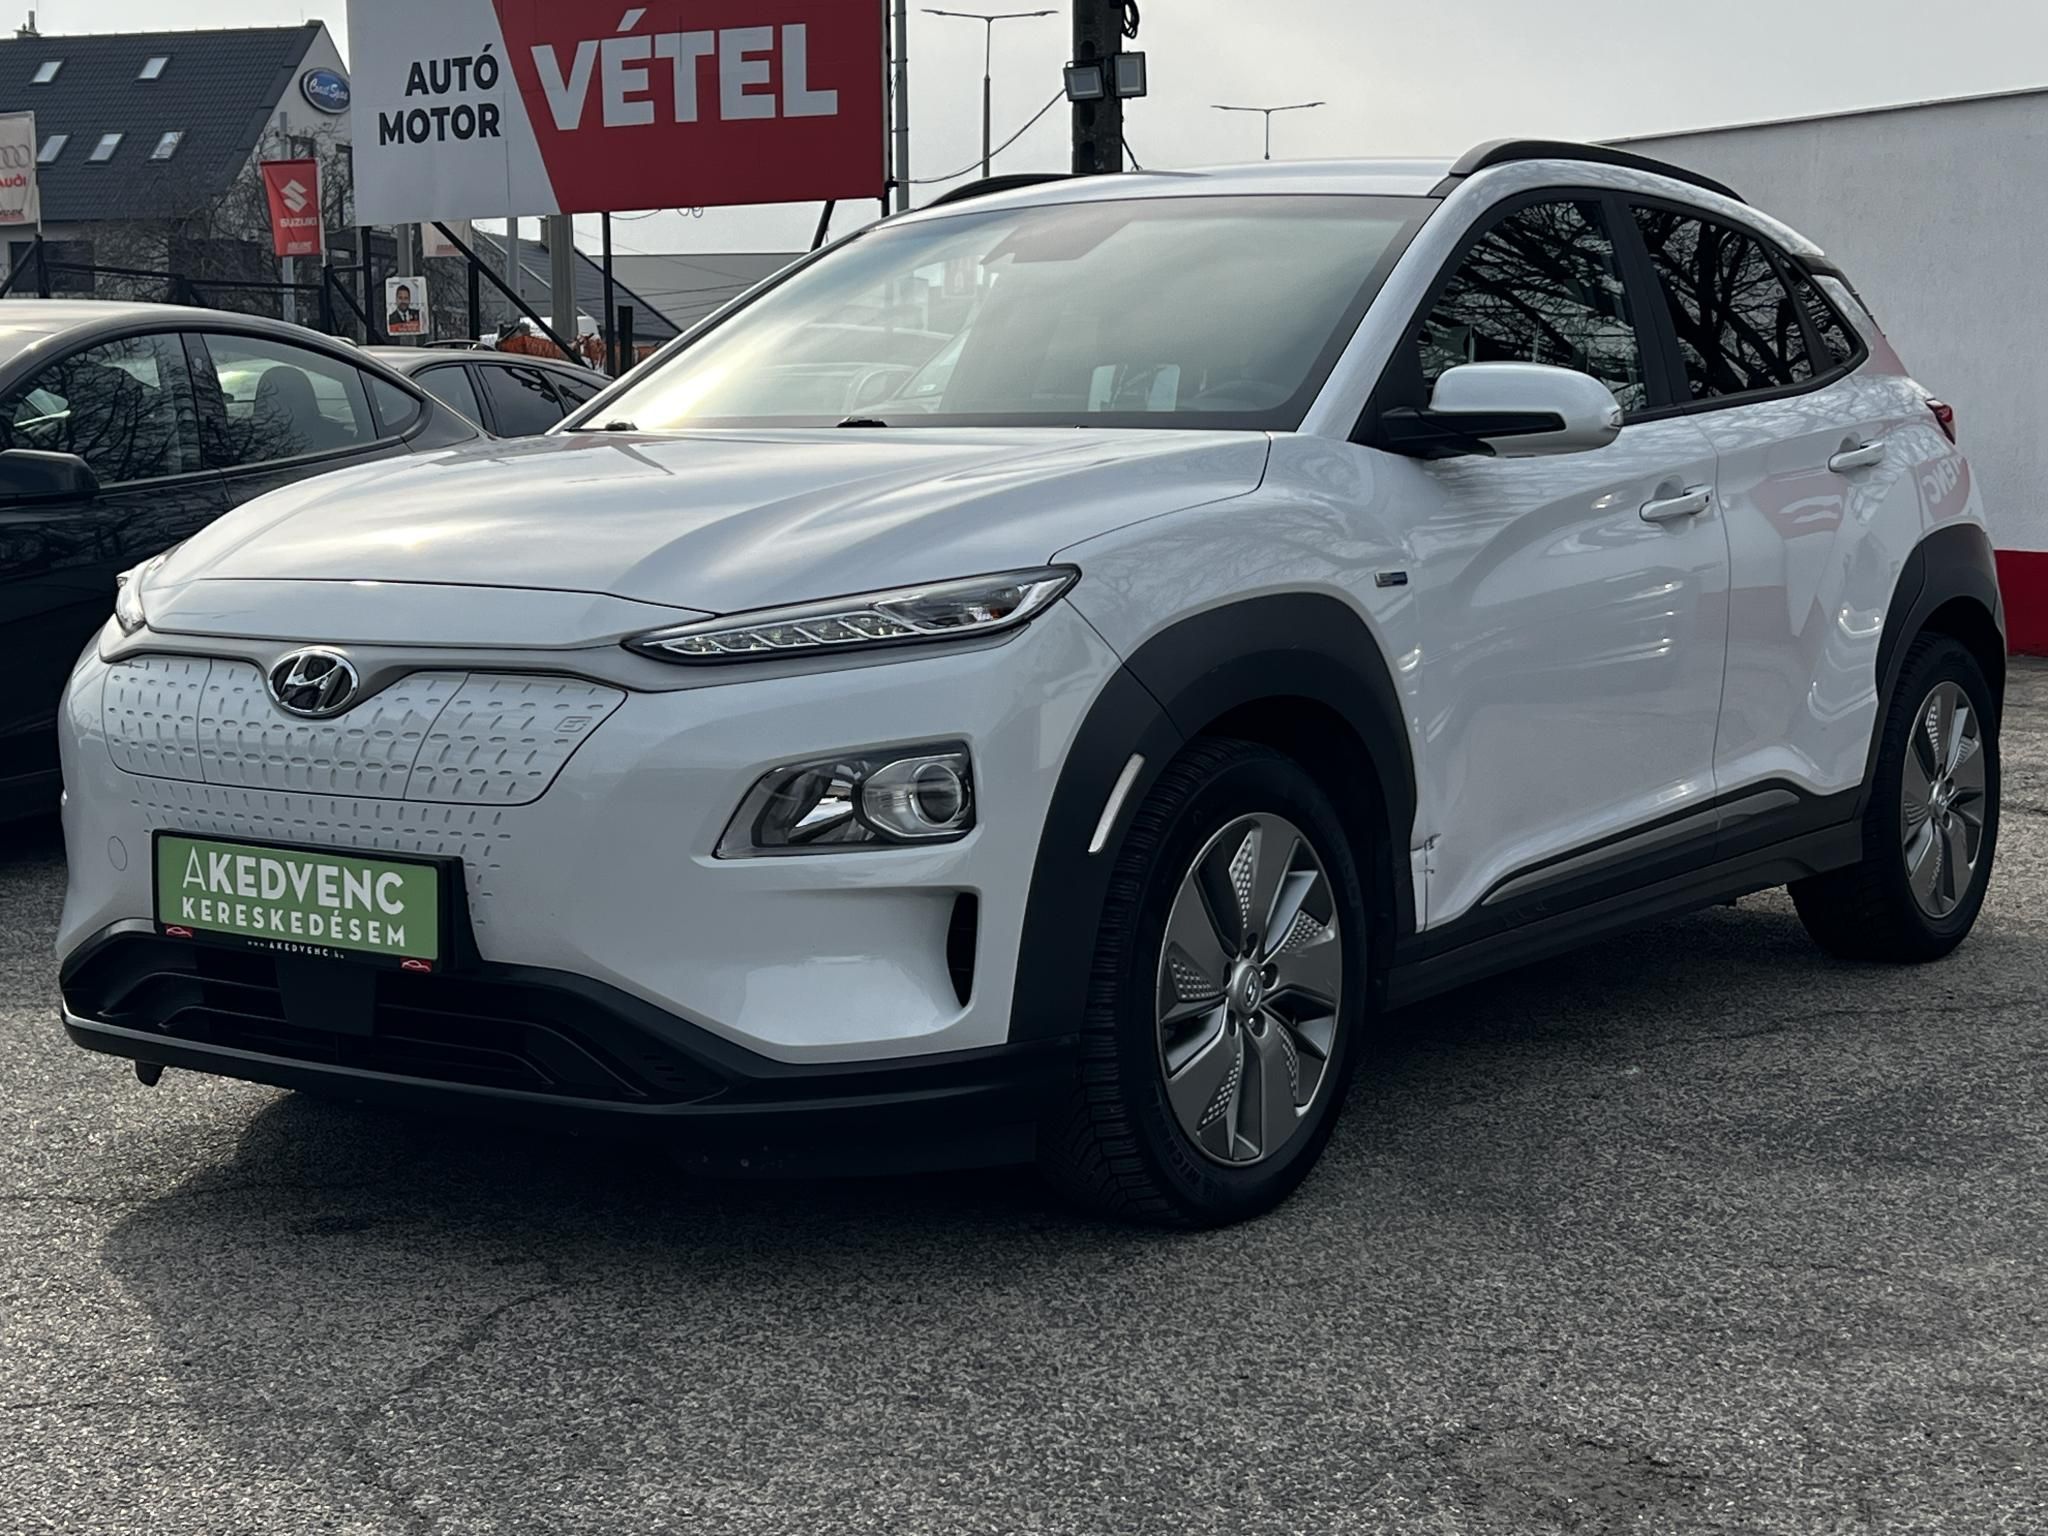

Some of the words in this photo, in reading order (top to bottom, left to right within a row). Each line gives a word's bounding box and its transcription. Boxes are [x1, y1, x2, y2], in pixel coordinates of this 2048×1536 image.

[405, 43, 499, 97] AUTÓ
[531, 8, 838, 130] VÉTEL
[378, 103, 501, 146] MOTOR
[279, 217, 317, 228] SUZUKI
[182, 846, 405, 915] AKEDVENC
[182, 896, 406, 947] KERESKEDÉSEM
